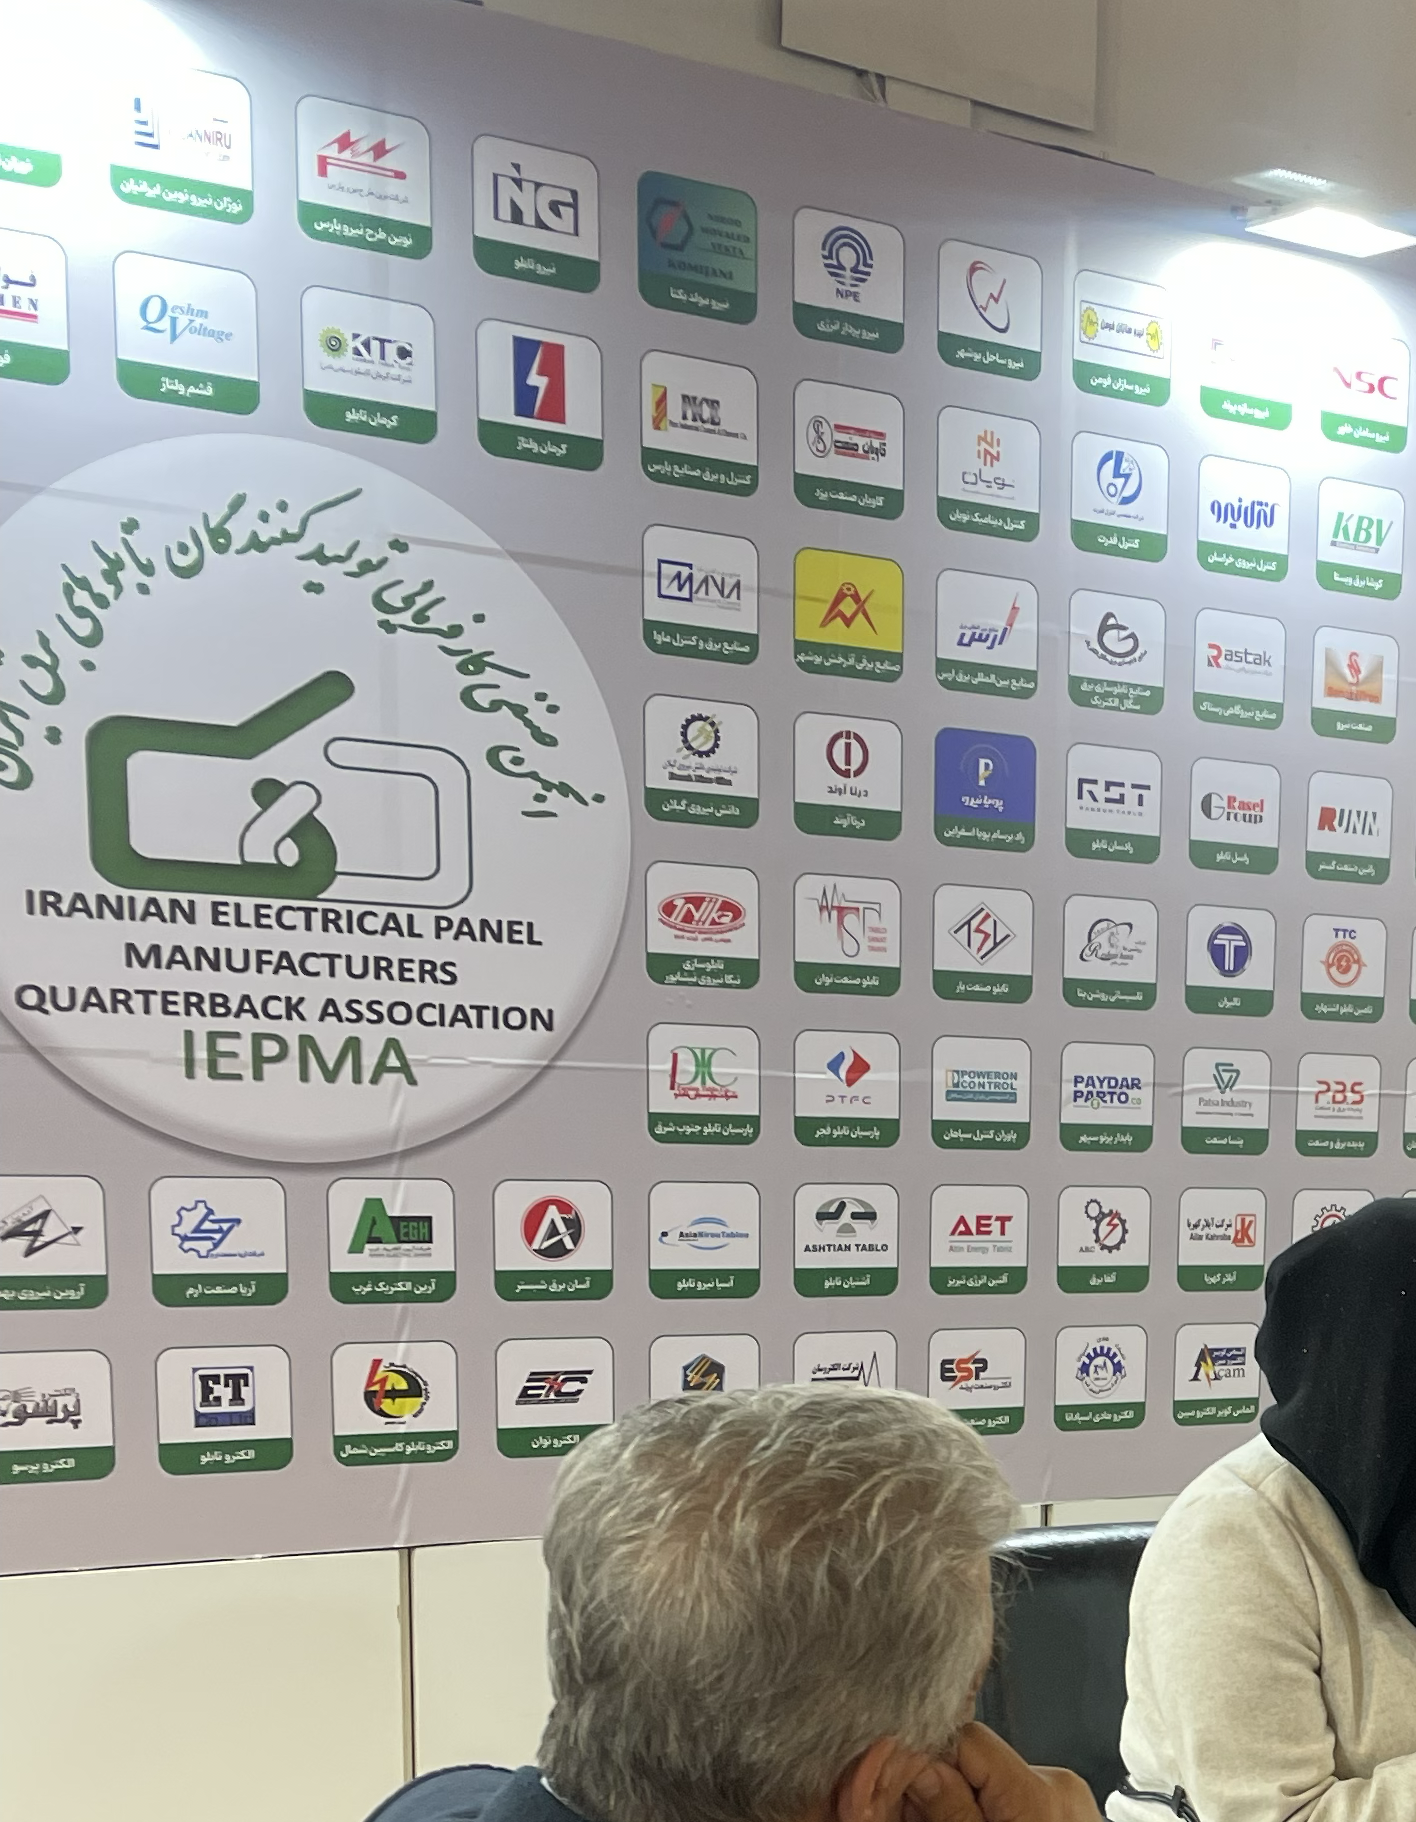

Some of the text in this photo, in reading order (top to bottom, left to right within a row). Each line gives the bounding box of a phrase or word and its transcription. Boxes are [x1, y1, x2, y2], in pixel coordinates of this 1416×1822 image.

[314, 218, 341, 236] پارس
[388, 233, 412, 248] نوین
[835, 287, 860, 302] NPE
[186, 382, 214, 398] قشم
[1331, 511, 1394, 548] KBV
[1207, 642, 1272, 668] Rastak
[1077, 778, 1151, 807] RST
[1226, 795, 1265, 814] Rasel
[24, 888, 544, 947] IRANIAN ELECTRICAL PANEL
[1332, 928, 1357, 940] TTC
[123, 941, 459, 986] MANUFACTURERS
[14, 983, 555, 1032] QUARTERBACK ASSOCIATION
[183, 1028, 418, 1087] IEPMA
[958, 1069, 1018, 1082] POWERON
[1073, 1074, 1142, 1090] PAYDAR
[959, 1080, 1018, 1092] CONTROL
[1073, 1090, 1129, 1106] PARTO
[950, 1214, 1014, 1236] AET
[804, 1242, 888, 1254] ASHTIAN TABLO
[940, 1350, 989, 1389] ESP
[198, 1373, 250, 1408] ET
